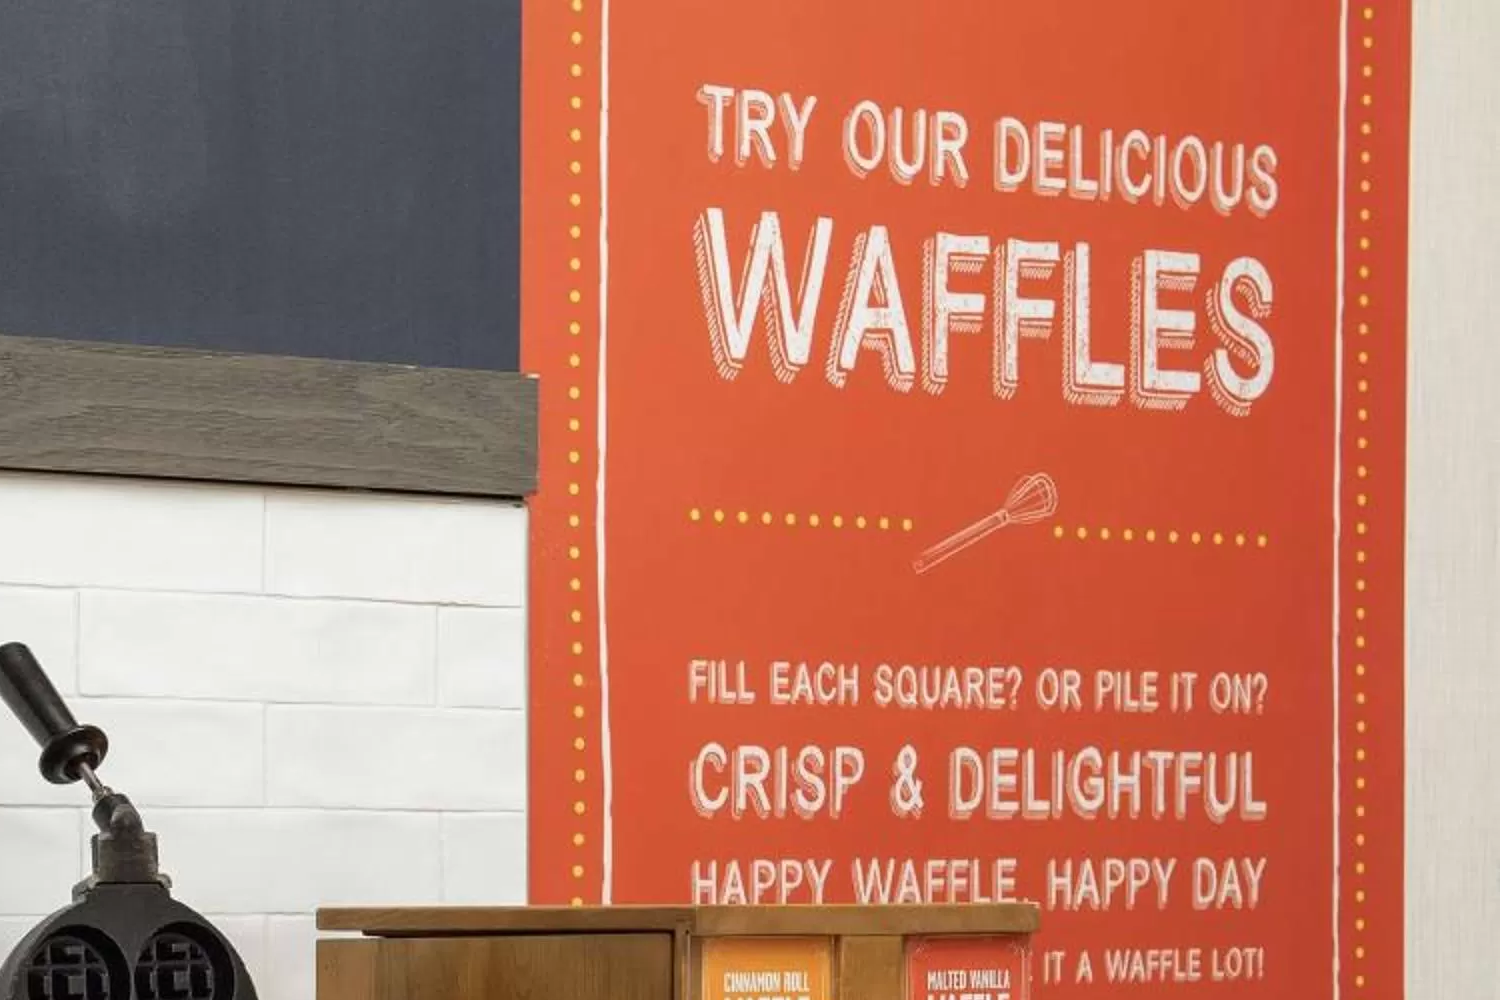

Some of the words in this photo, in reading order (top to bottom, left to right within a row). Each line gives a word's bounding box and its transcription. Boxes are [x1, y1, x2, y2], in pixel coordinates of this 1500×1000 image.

[695, 84, 817, 170] TRY
[841, 100, 970, 187] OUR
[994, 117, 1278, 217] DELICIOUS
[692, 207, 1274, 416] WAFFLES
[689, 659, 754, 704] FILL
[769, 661, 859, 706] EACH
[874, 664, 1023, 709] SQUARE?
[1035, 667, 1082, 709] OR
[1093, 670, 1160, 713] PILE
[1170, 671, 1198, 713] IT
[1208, 672, 1269, 715] ON?
[689, 742, 864, 818] CRISP
[891, 744, 924, 819] &
[949, 746, 1268, 822] DELIGHTFUL
[691, 858, 832, 905] HAPPY
[1046, 857, 1177, 912] HAPPY
[1191, 857, 1267, 912] DAY
[723, 971, 781, 993] CINNAMON
[783, 971, 810, 993] ROLL
[927, 969, 967, 991] MALTED
[969, 968, 1011, 989] VANILLA
[1042, 950, 1065, 984] IT
[1075, 950, 1093, 983] A
[1105, 949, 1202, 982] WAFFLE
[1210, 947, 1265, 981] LOT!
